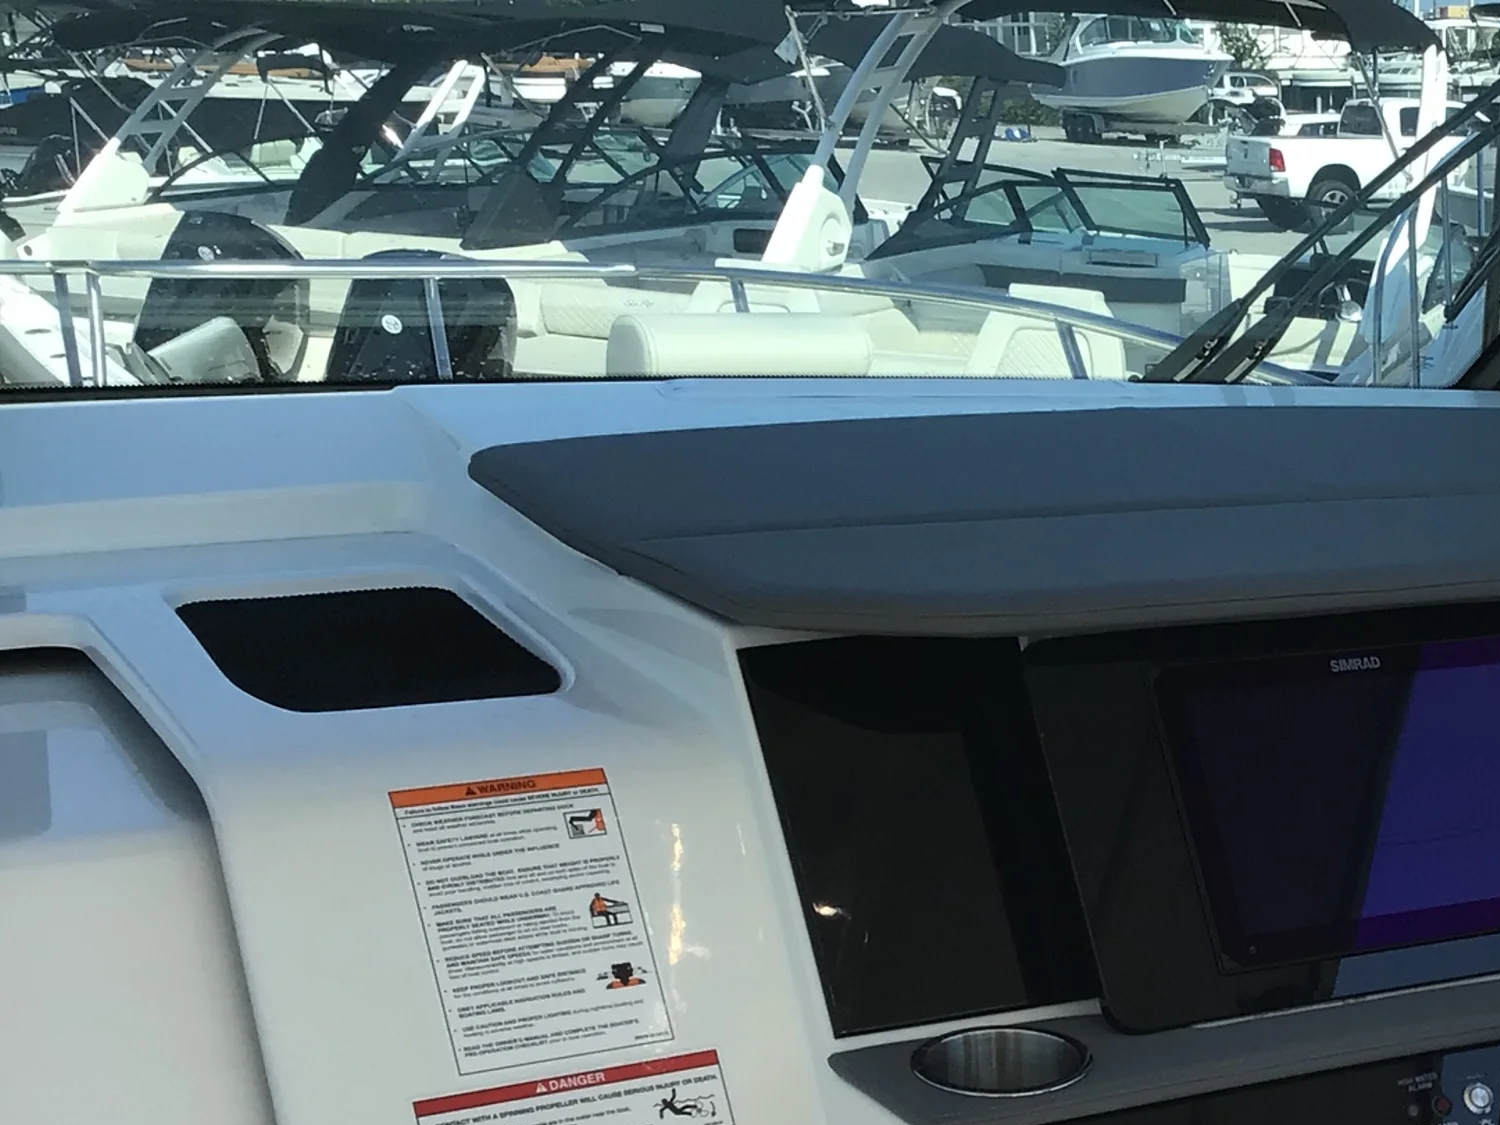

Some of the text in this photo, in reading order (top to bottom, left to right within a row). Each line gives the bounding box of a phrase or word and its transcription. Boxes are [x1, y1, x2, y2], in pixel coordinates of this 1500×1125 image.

[1329, 655, 1381, 673] SIMRAD
[477, 779, 536, 794] WARNING
[549, 1071, 605, 1090] DANGER
[471, 1113, 491, 1124] WITH
[491, 1112, 498, 1120] A
[498, 1105, 535, 1119] SPINNING
[534, 1097, 579, 1112] PROPELLER
[578, 1094, 597, 1104] WILL
[597, 1090, 622, 1101] CAUSE
[622, 1084, 655, 1096] SERIOUS
[654, 1079, 681, 1091] INJURY
[680, 1077, 692, 1086] OR
